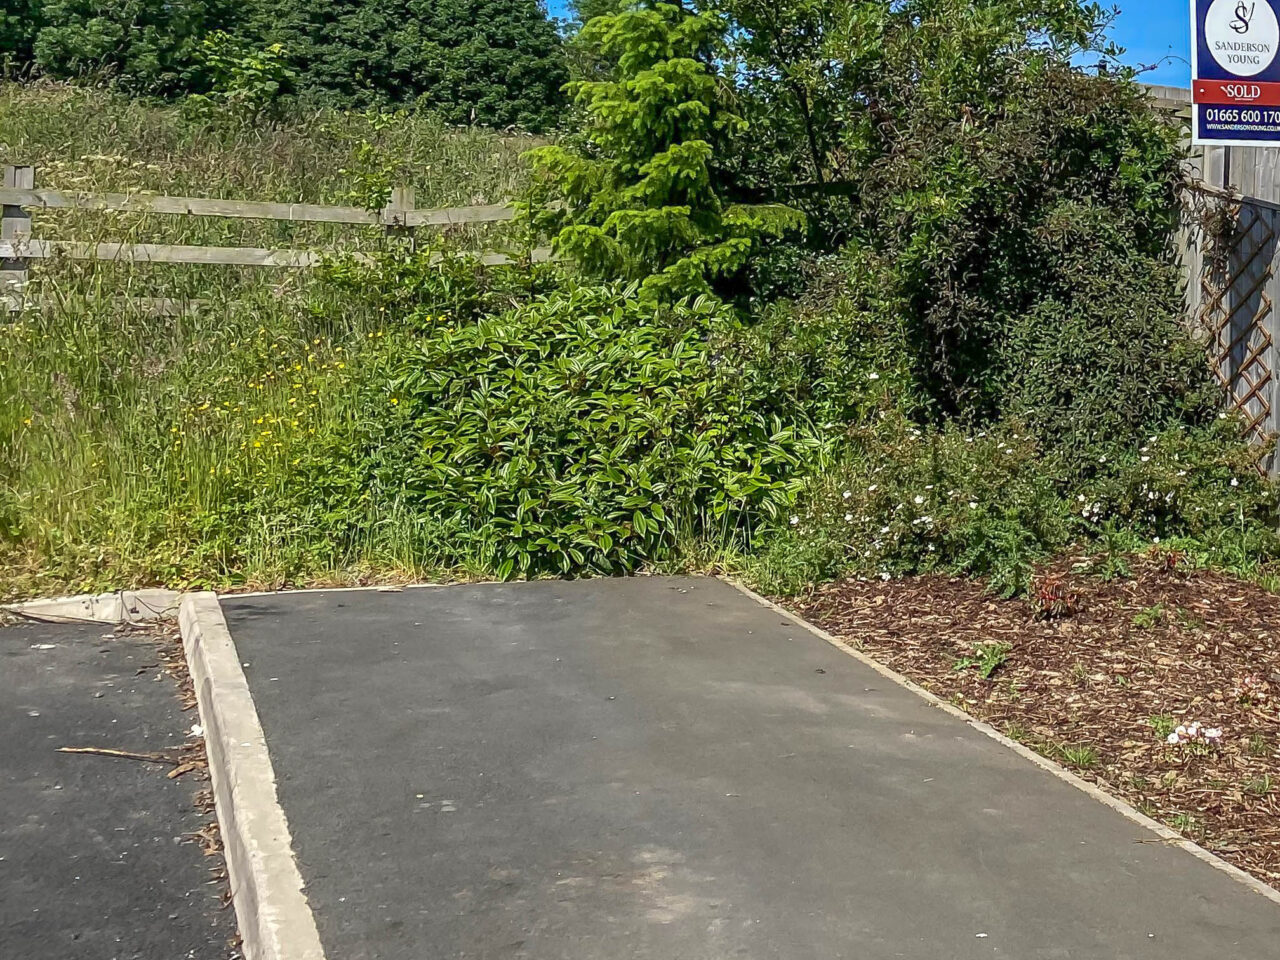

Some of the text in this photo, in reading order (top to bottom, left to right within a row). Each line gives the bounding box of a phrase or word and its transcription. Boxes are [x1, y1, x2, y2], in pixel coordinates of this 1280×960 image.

[1215, 41, 1270, 52] SANDERSON
[1227, 54, 1260, 64] YOUNG
[1226, 84, 1260, 98] SOLD
[1206, 109, 1238, 121] 01665
[1241, 110, 1260, 122] 600
